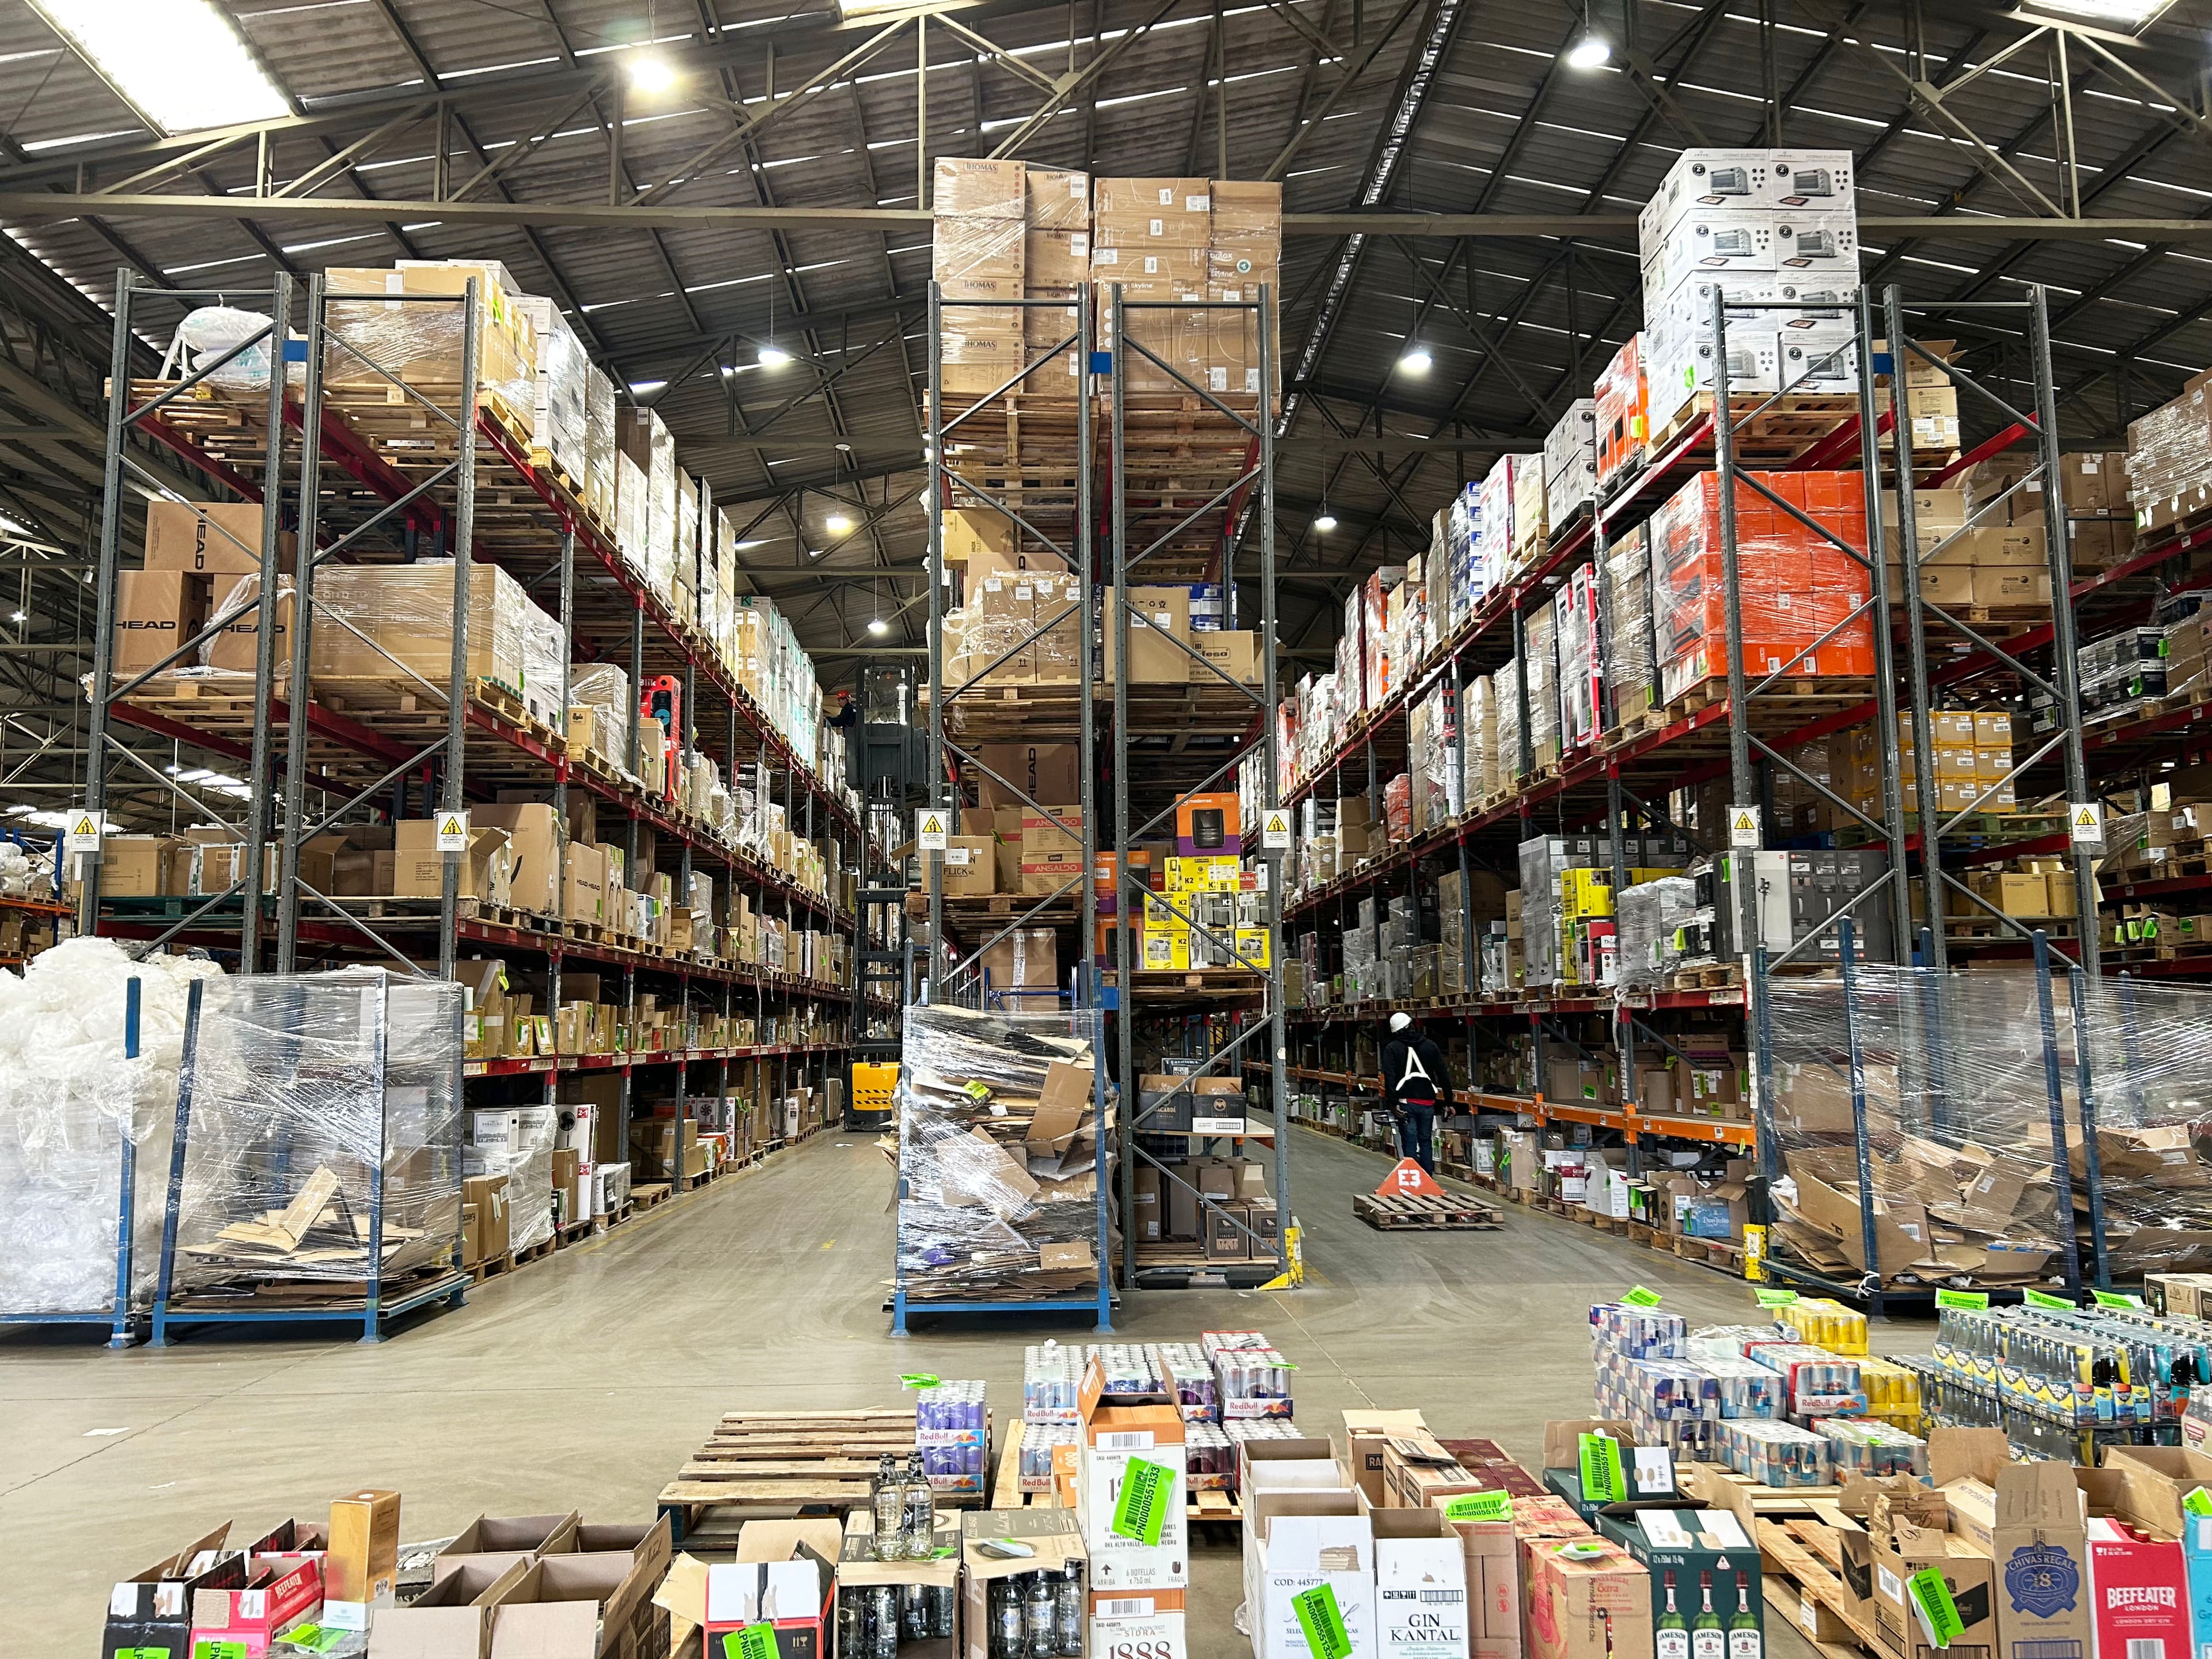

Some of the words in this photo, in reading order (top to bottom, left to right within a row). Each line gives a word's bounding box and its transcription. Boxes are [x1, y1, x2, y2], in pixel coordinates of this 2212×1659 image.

[1028, 747, 1036, 803] HEAD
[577, 878, 588, 887] HEAD
[588, 883, 601, 891] HEAD
[1398, 1169, 1421, 1188] E3
[1599, 1438, 1613, 1501] LPN0000551498
[1135, 1466, 1160, 1542] LPN0000551333
[2009, 1555, 2042, 1571] CHIVAS
[2044, 1555, 2073, 1570] REGAL
[1131, 1568, 1156, 1576] BOTELLAS
[275, 1573, 302, 1599] BEEFEATER
[2107, 1586, 2176, 1609] BEEFEATER
[1408, 1613, 1440, 1627] GIN
[1391, 1629, 1459, 1641] KANTAL
[1658, 1632, 1685, 1641] JAMESON
[1695, 1632, 1722, 1641] JAMESON
[1731, 1632, 1758, 1641] JAMESON
